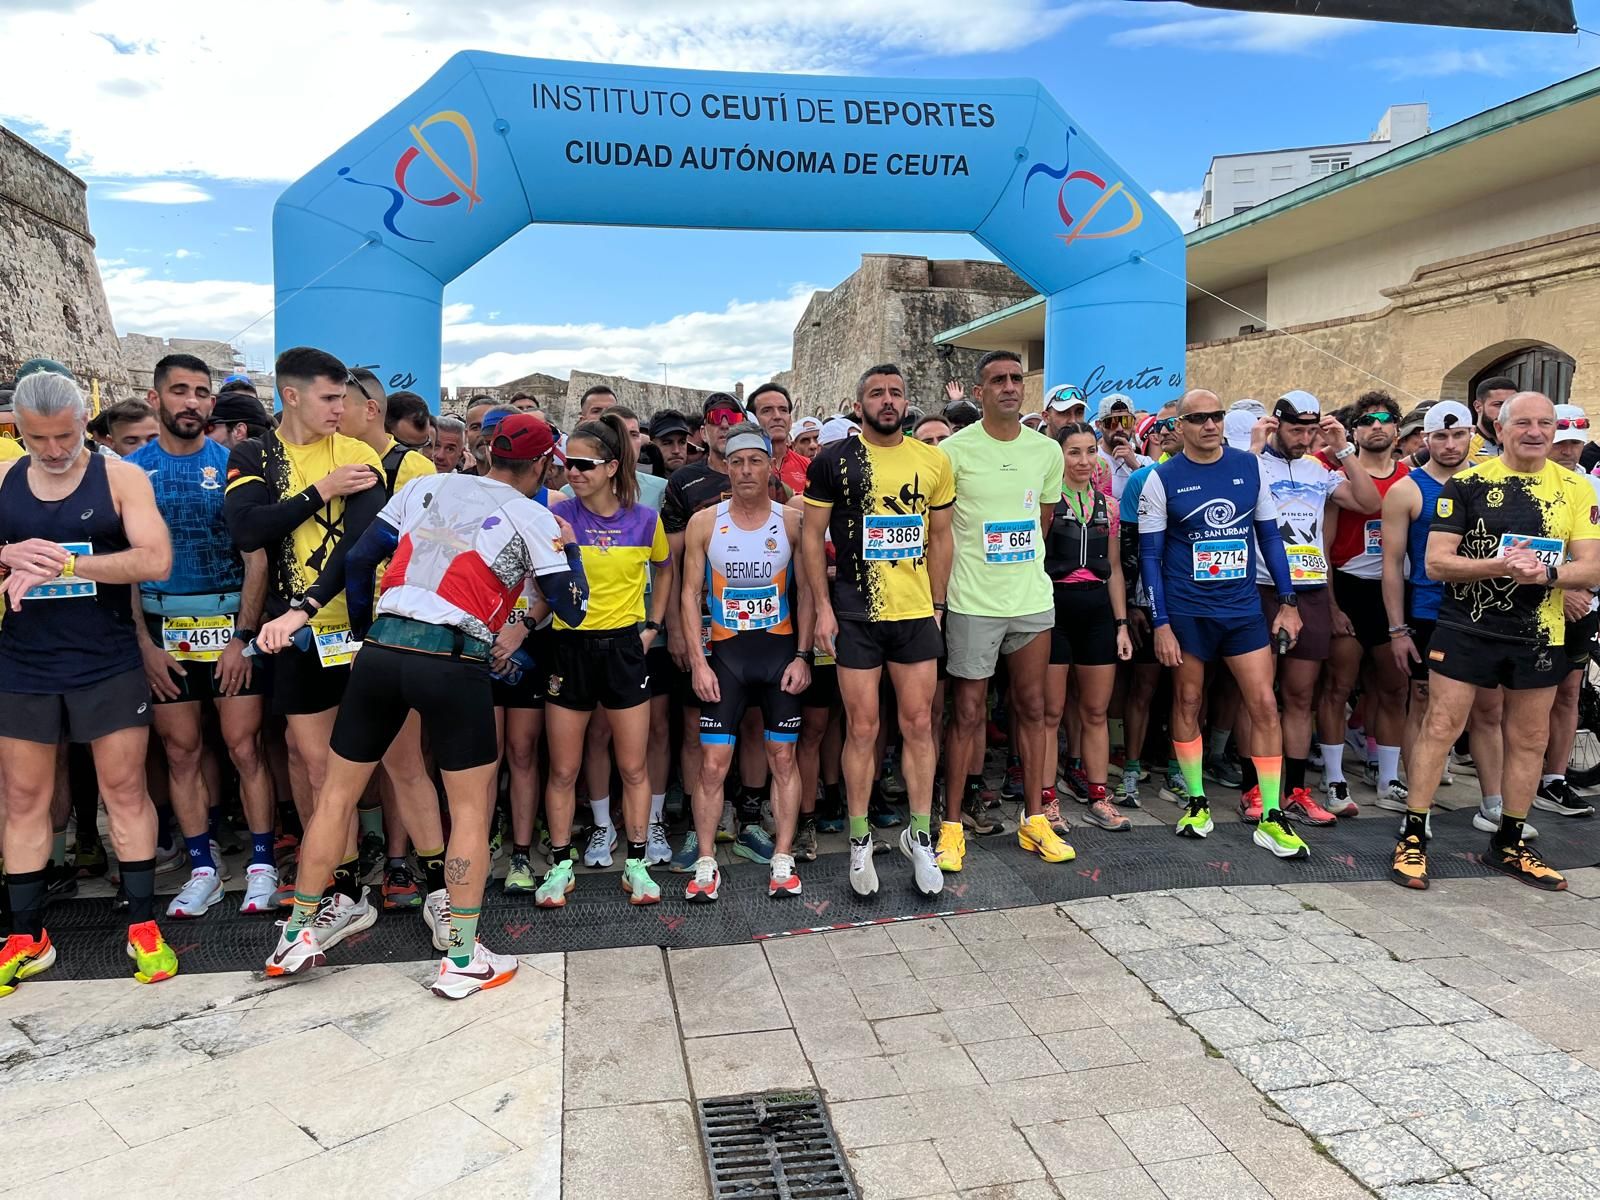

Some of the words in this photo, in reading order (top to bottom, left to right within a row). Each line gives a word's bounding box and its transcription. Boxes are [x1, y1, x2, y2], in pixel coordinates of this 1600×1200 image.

[532, 83, 692, 118] INSTITUTO
[701, 93, 788, 122] CEUTÍ
[797, 98, 836, 124] DE
[844, 100, 995, 128] DEPORTES
[565, 140, 673, 168] CIUDAD
[680, 144, 836, 173] AUTÓNOMA
[844, 153, 878, 175] DE
[886, 153, 970, 176] CEUTA
[389, 372, 418, 389] es
[1169, 372, 1183, 387] es
[886, 527, 920, 543] 3869
[1009, 532, 1031, 547] 664
[1204, 530, 1222, 538] SAN
[1214, 551, 1244, 565] 2714
[1301, 555, 1326, 568] 5898
[725, 561, 772, 579] BERMEJO
[746, 598, 772, 614] 916
[189, 629, 231, 646] 4619
